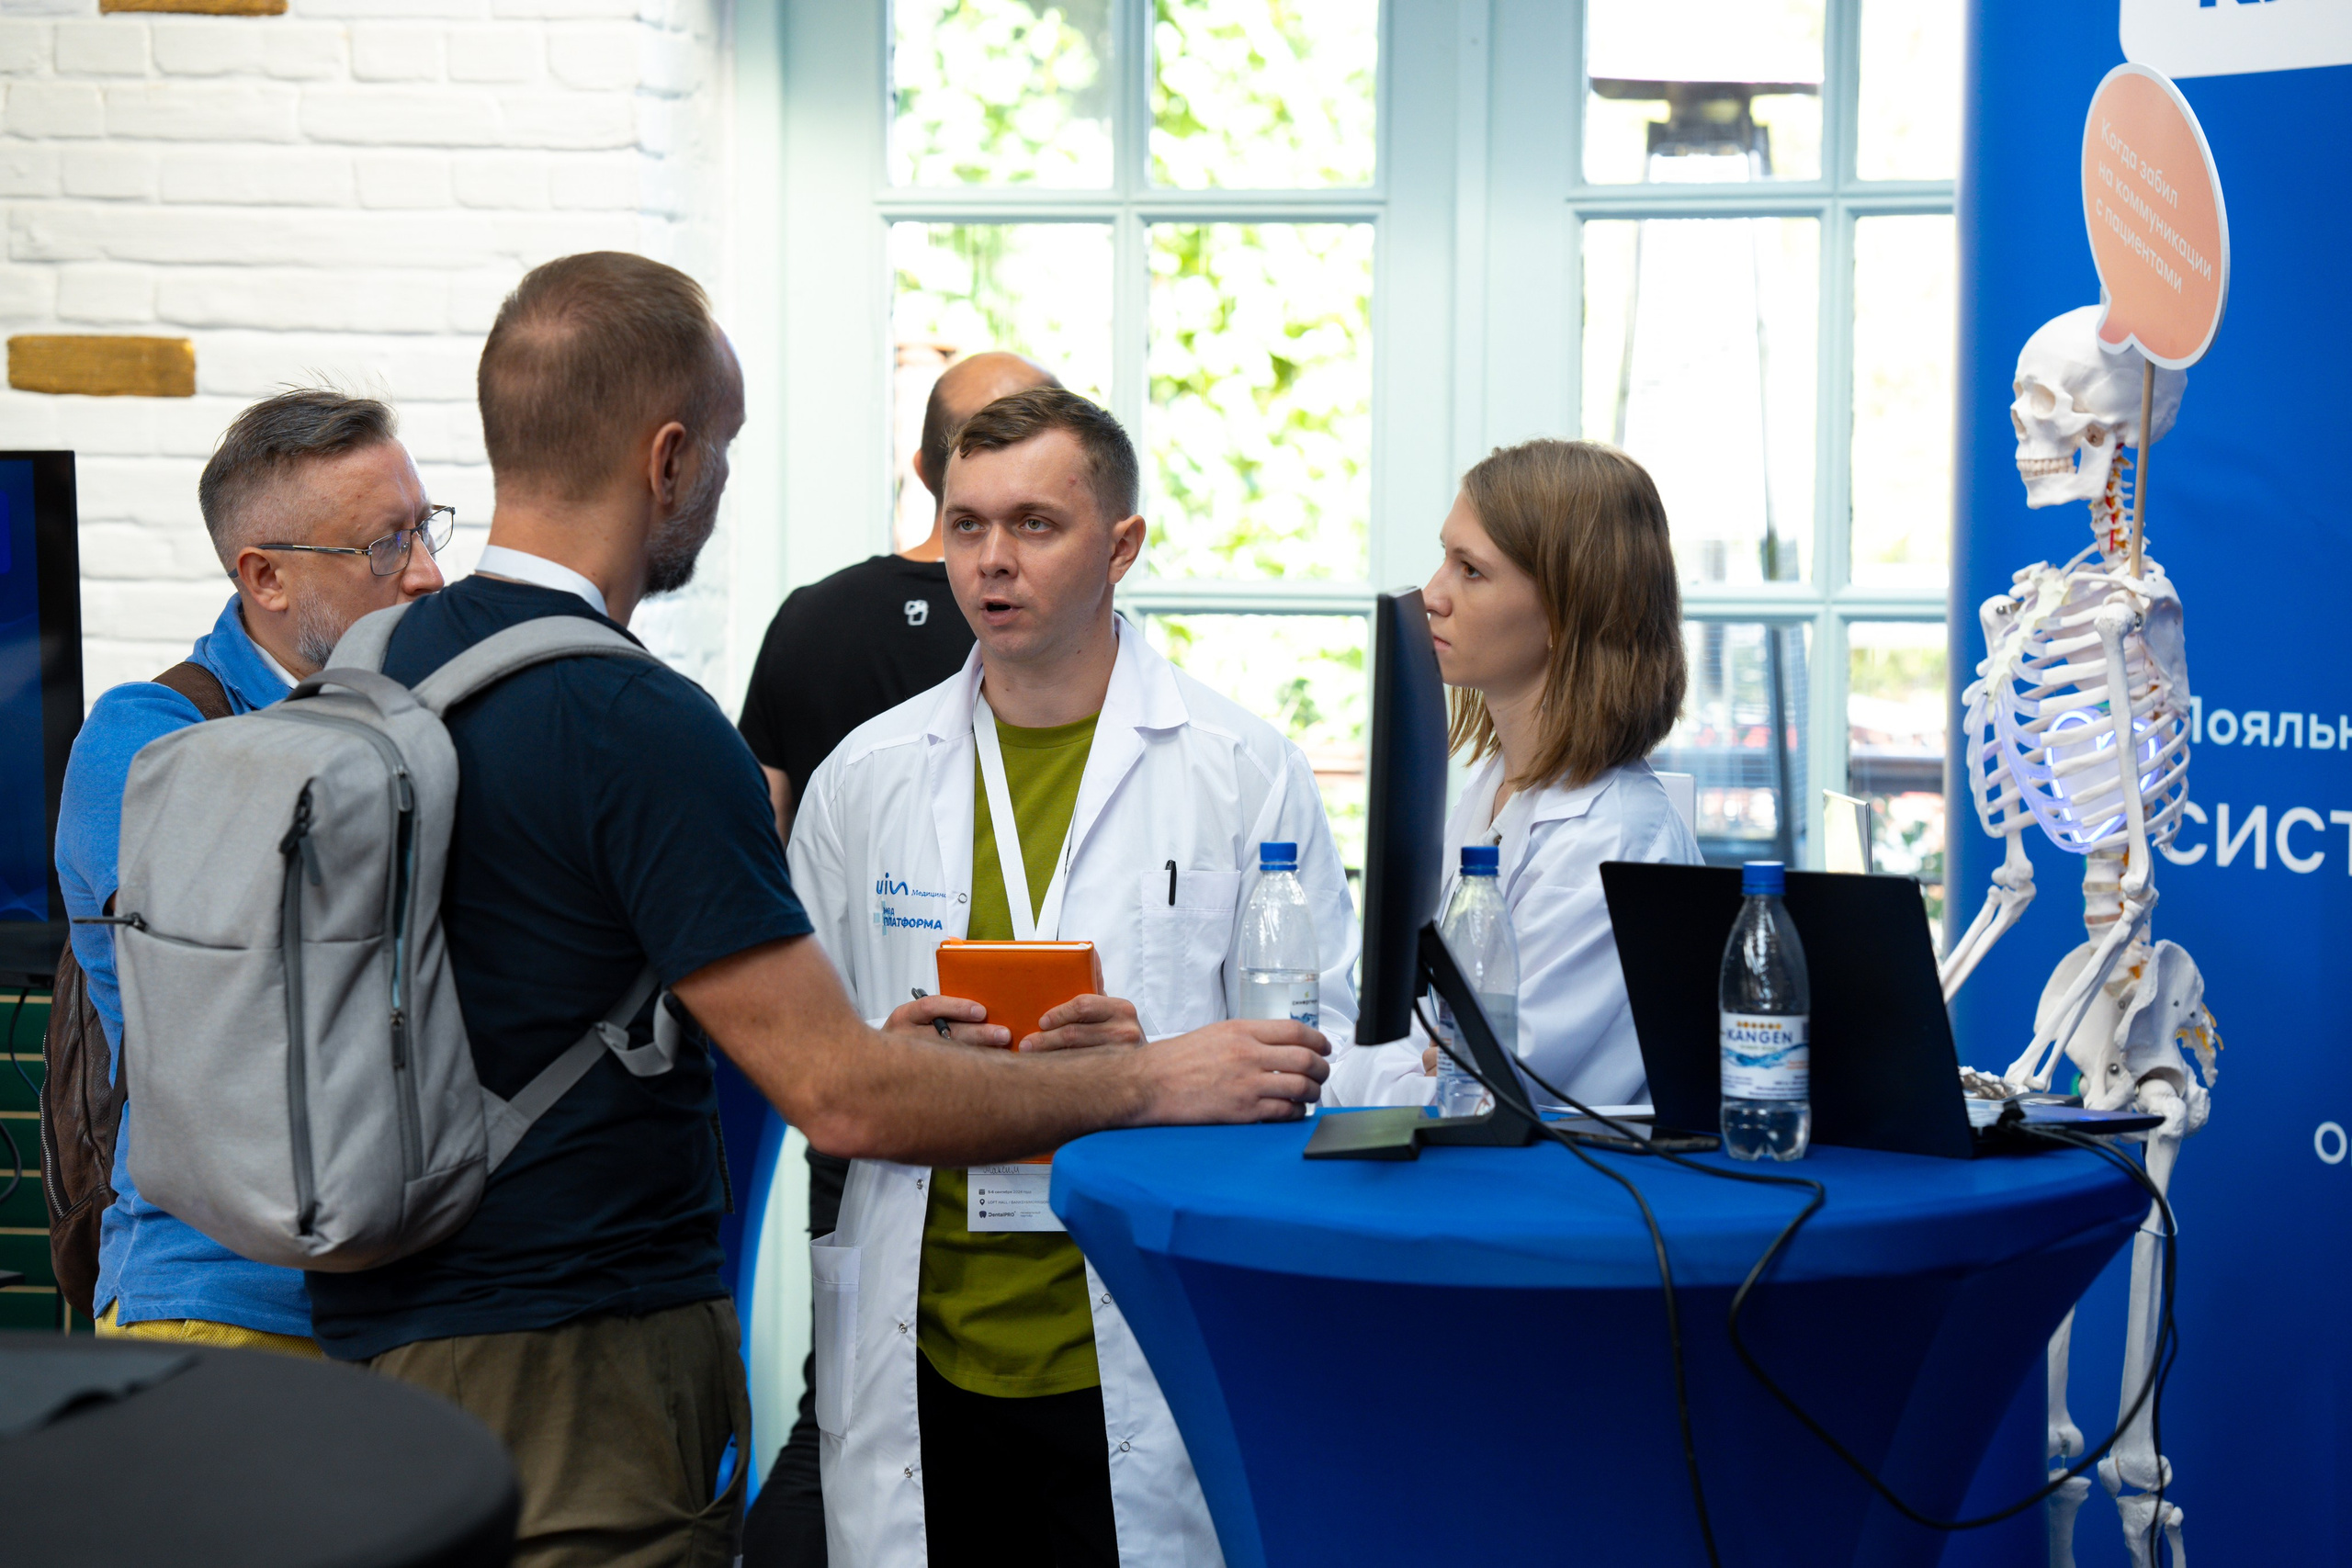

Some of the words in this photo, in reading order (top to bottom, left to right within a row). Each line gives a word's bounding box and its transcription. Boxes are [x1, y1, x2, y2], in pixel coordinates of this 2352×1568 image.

[2101, 118, 2137, 170] Когда
[2140, 161, 2177, 209] забил
[2096, 197, 2103, 217] с
[2106, 206, 2182, 294] пациентами
[2098, 160, 2113, 188] на
[2116, 176, 2212, 282] коммуникации
[883, 917, 943, 931] ПЛАТФОРМА
[1727, 1029, 1792, 1044] KANGEN
